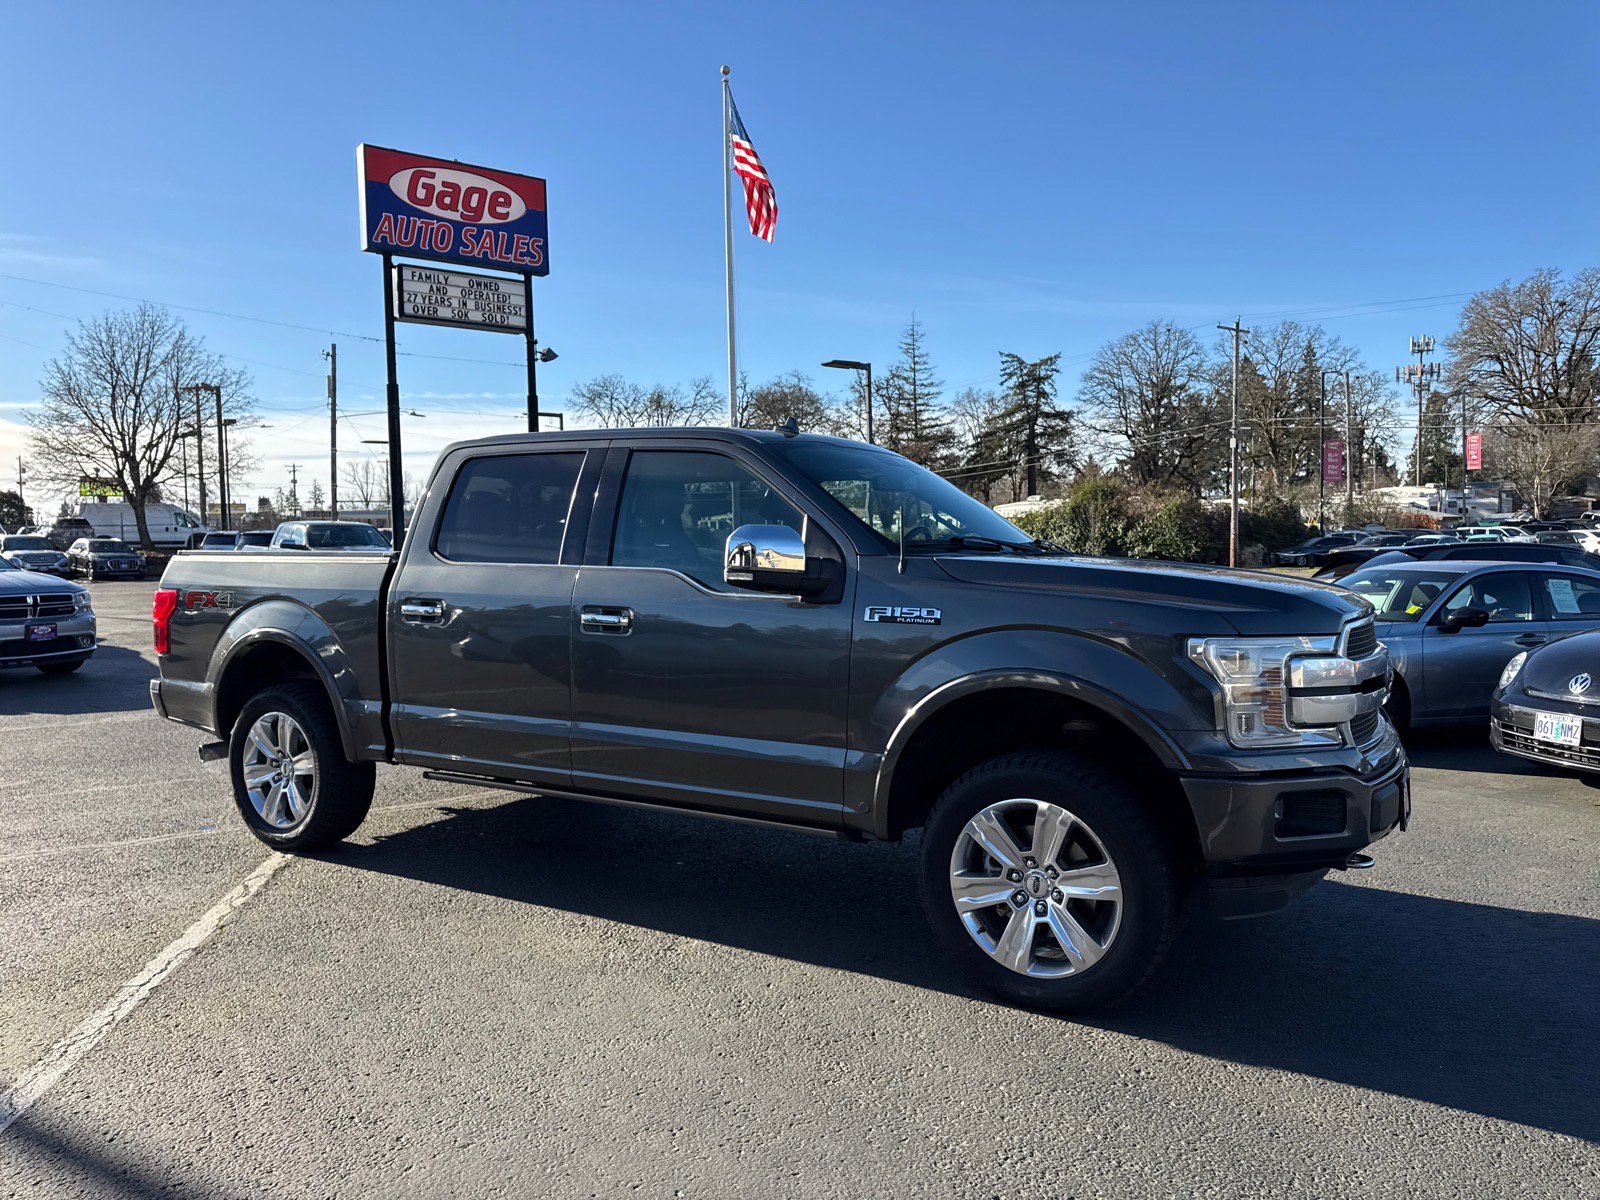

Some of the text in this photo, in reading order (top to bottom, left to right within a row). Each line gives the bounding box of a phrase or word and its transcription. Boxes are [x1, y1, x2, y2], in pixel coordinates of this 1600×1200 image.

[407, 169, 512, 222] Gage
[373, 213, 544, 266] AUTO SALES
[411, 271, 500, 292] FAMILY OWNED
[406, 292, 522, 316] 27 YEARS IN BUSINESS!
[428, 284, 511, 304] AND OPERATED!
[412, 304, 439, 317] OVER
[481, 312, 510, 324] SOLD!
[186, 590, 234, 609] FX4
